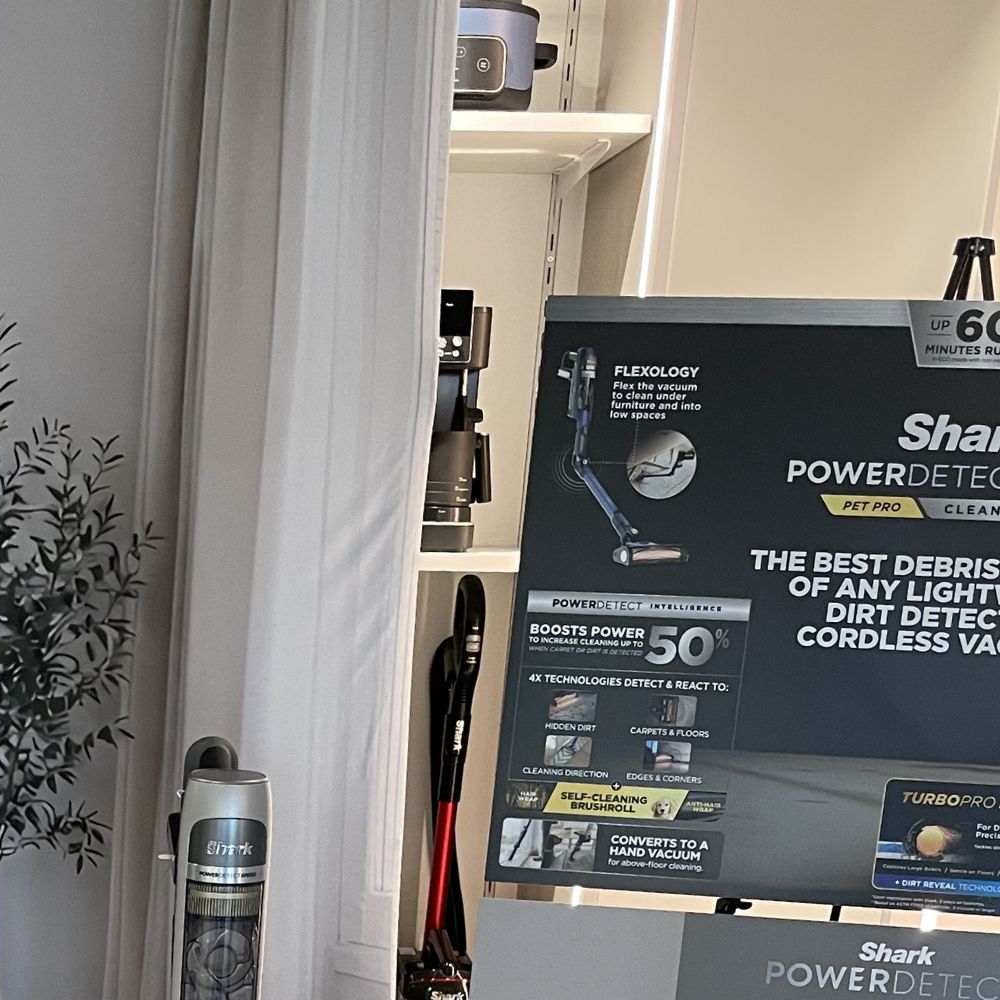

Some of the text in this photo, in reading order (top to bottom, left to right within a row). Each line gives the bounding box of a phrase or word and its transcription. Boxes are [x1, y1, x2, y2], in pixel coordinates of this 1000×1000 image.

[931, 320, 950, 331] UP
[925, 344, 981, 355] MINUTES
[614, 365, 700, 378] FLEXOLOGY
[613, 381, 635, 390] Flex
[637, 382, 655, 391] the
[612, 391, 687, 401] to clean under
[611, 400, 702, 411] furniture and into
[609, 410, 666, 421] low spaces
[842, 501, 902, 512] PET PRO
[750, 549, 1000, 580] THE BEST DEBRIS
[789, 576, 830, 598] OF
[835, 577, 900, 600] ANY
[552, 598, 722, 612] POWERDETECT INTELLIGENCE
[826, 602, 895, 625] DIRT
[530, 623, 646, 640] BOOSTS POWER
[541, 637, 579, 645] INCREASE
[580, 638, 619, 647] CLEANING
[797, 626, 950, 653] CORDLESS
[529, 674, 730, 693] 4X TECHNOLOGIES DETECT & REACT TO:
[545, 722, 597, 732] HIDDEN DIRT
[630, 727, 710, 738] CARPETS & FLOORS
[453, 720, 465, 751] Shark
[522, 767, 609, 779] CLEANING DIRECTION
[626, 773, 703, 784] EDGES & CORNERS
[561, 791, 648, 805] SELF-CLEANING
[902, 791, 997, 809] TURBOPRO
[570, 801, 636, 814] BRUSHROLL
[977, 823, 992, 831] For
[610, 835, 709, 851] CONVERTS TO A
[609, 846, 701, 861] HAND VACUUM
[608, 858, 704, 873] for above-floor cleaning.
[902, 880, 922, 888] DIRT
[923, 881, 956, 890] REVEAL
[859, 942, 936, 966] Shark
